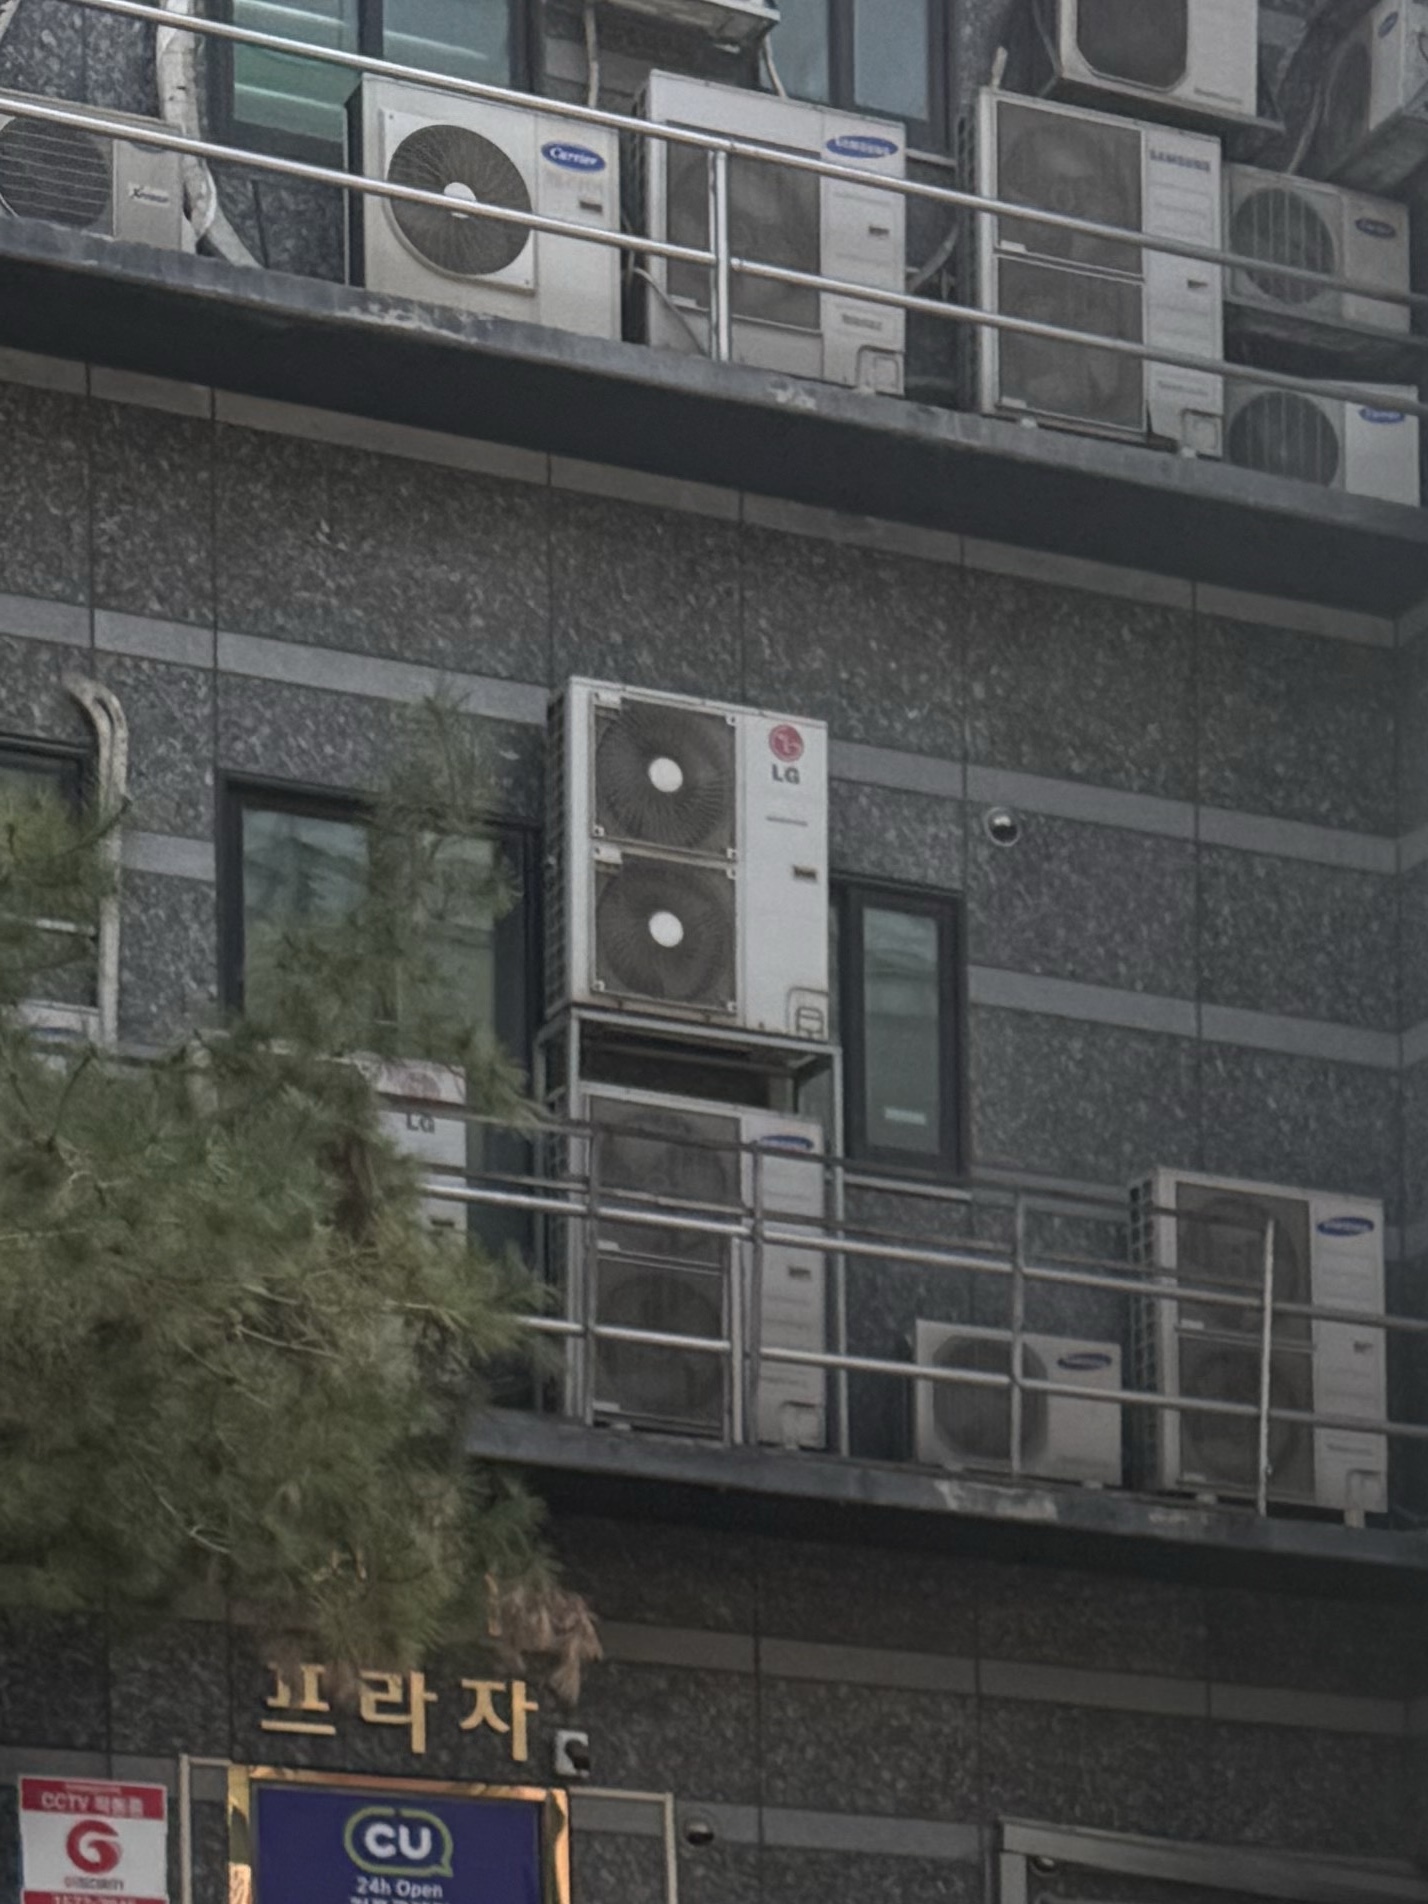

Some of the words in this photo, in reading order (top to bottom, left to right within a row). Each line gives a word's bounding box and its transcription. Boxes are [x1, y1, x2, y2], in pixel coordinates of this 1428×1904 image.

[550, 145, 598, 168] Carrier
[772, 763, 801, 785] LG
[261, 1662, 539, 1762] 프라자
[41, 1791, 89, 1812] CCTV
[364, 1822, 433, 1860] CU
[355, 1876, 392, 1896] 24h
[395, 1878, 443, 1900] Open
